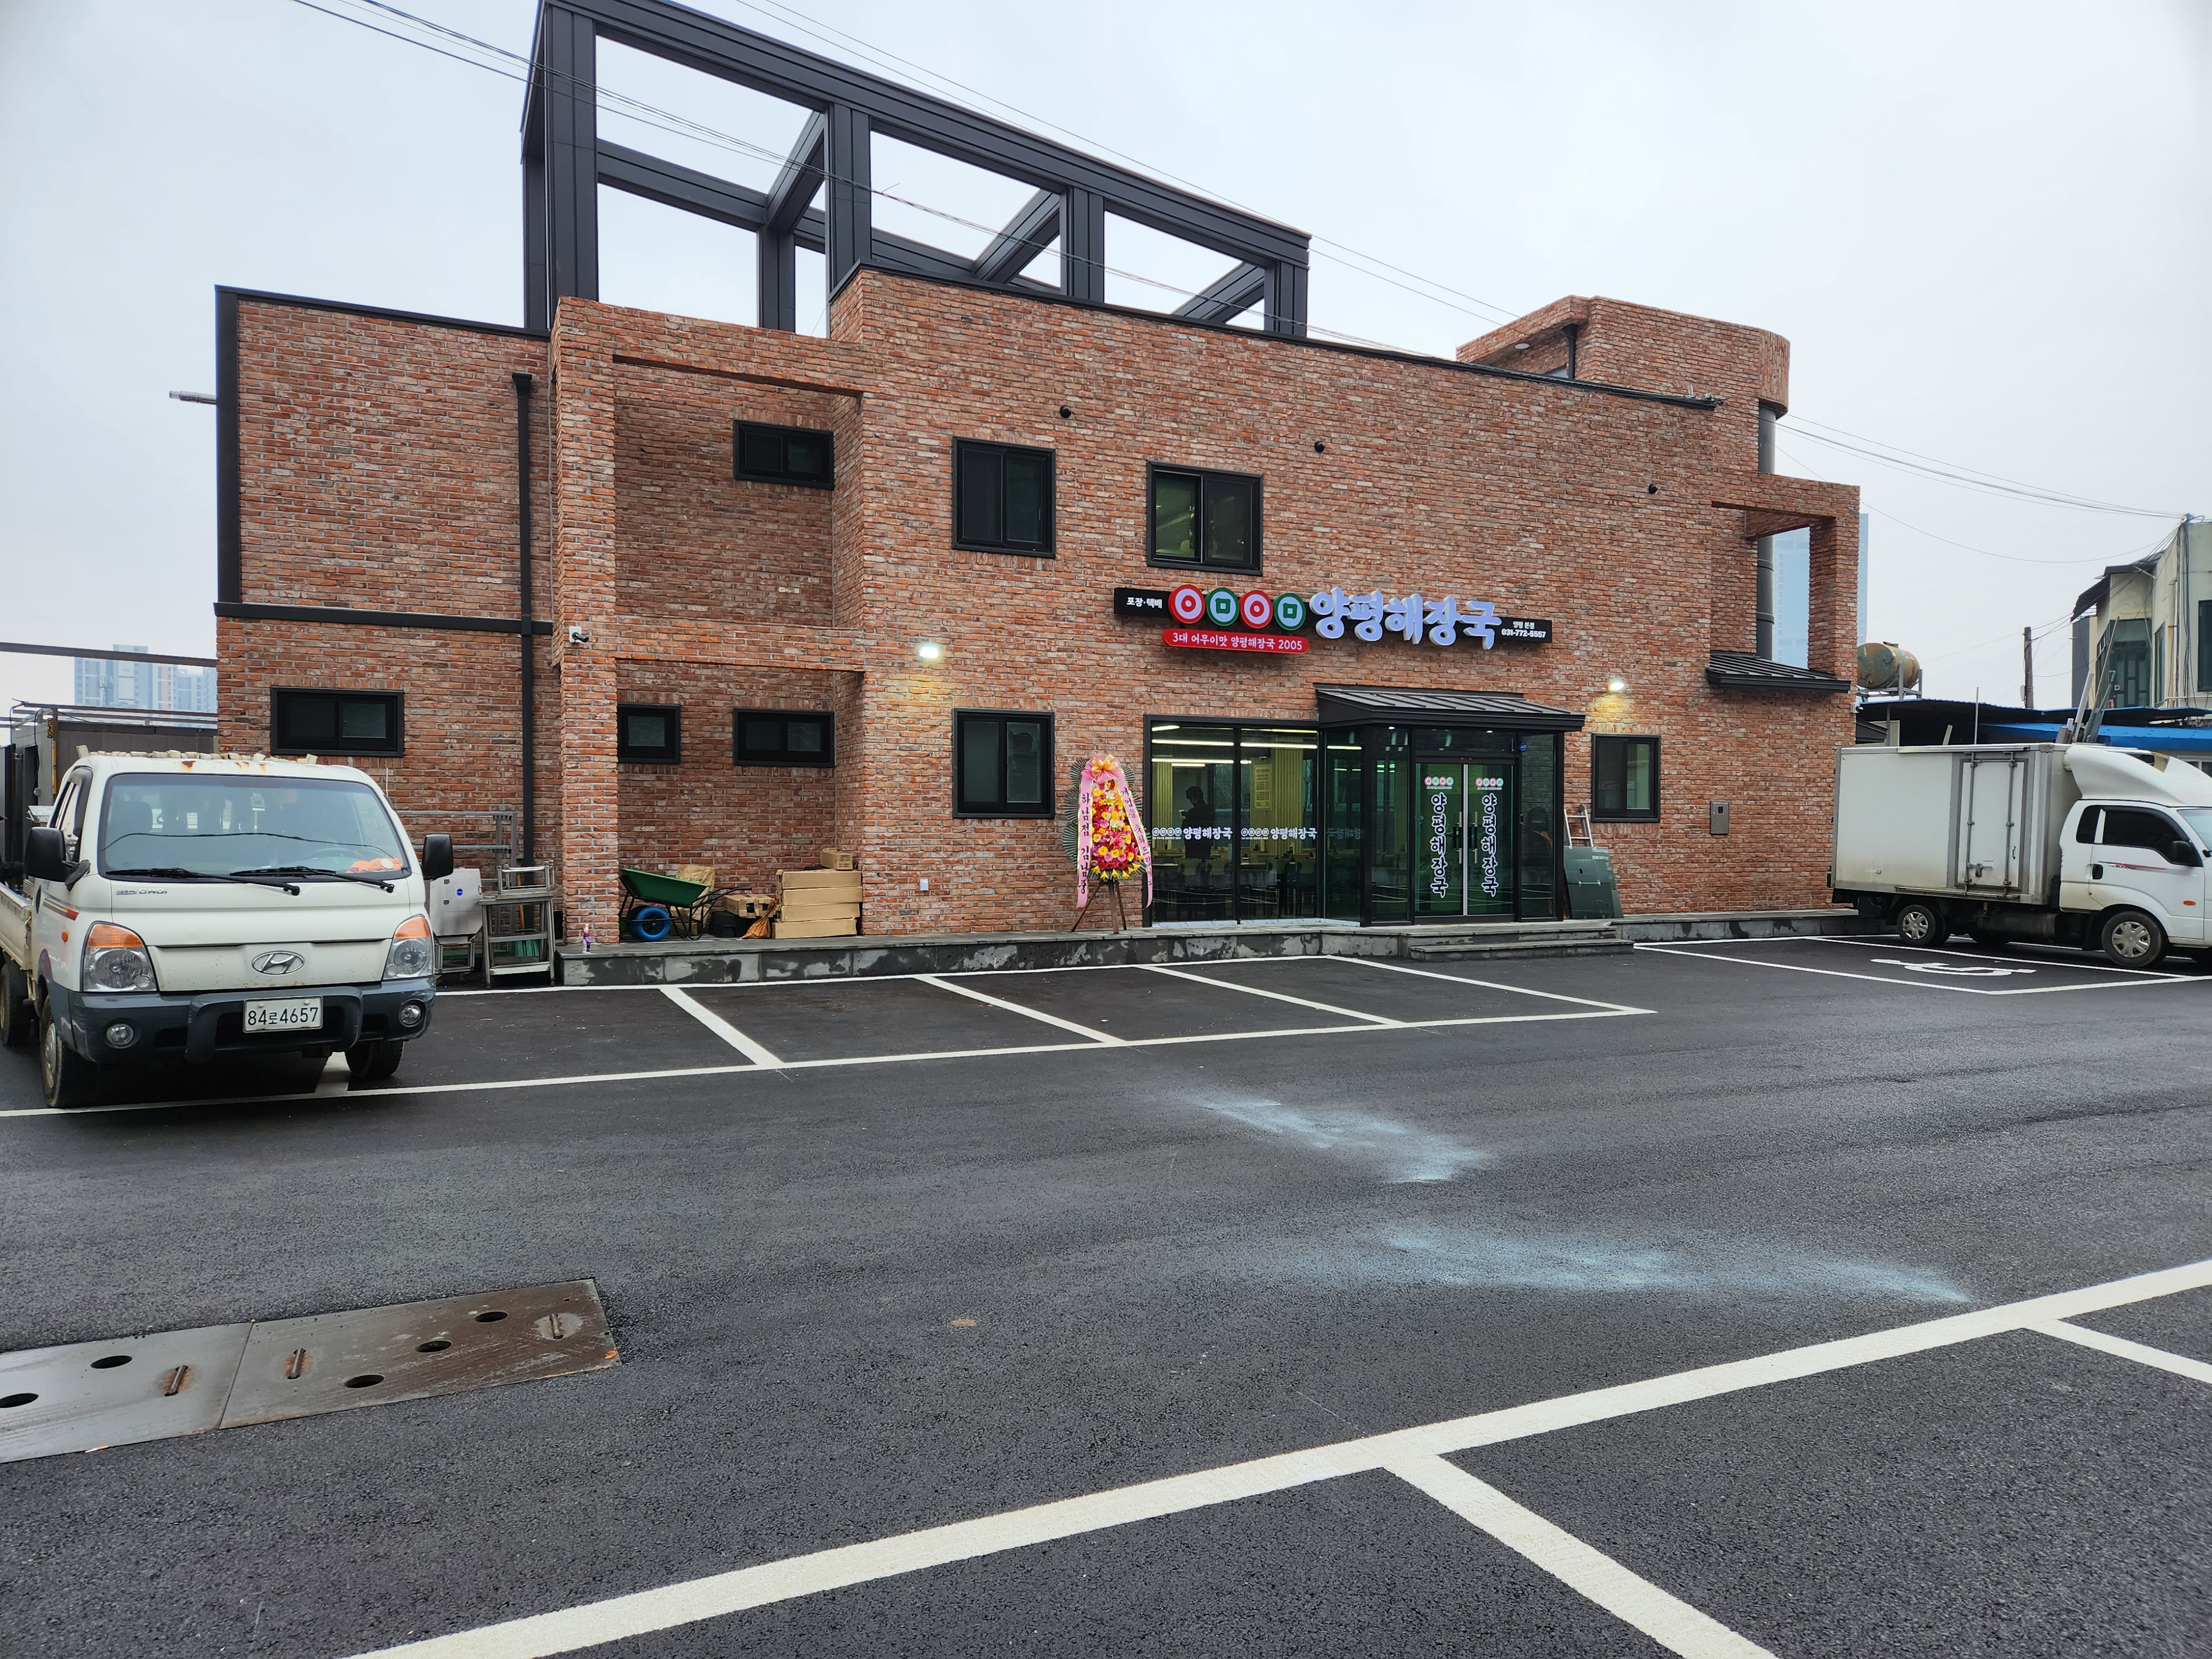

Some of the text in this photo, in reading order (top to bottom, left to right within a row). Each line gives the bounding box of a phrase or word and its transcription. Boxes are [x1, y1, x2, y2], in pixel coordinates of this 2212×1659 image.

[1309, 587, 1502, 650] 양평해장국
[1172, 632, 1302, 650] 3대 어무이맛 양평해장국 2005
[1501, 628, 1546, 638] 031-772-5557
[1081, 792, 1091, 837] 하남점
[1183, 826, 1233, 840] 양평해장국
[1270, 827, 1318, 840] 양평해장국
[1430, 792, 1449, 899] 양평해장국
[1481, 792, 1499, 898] 양평해장국
[248, 1007, 319, 1026] 84로4657
